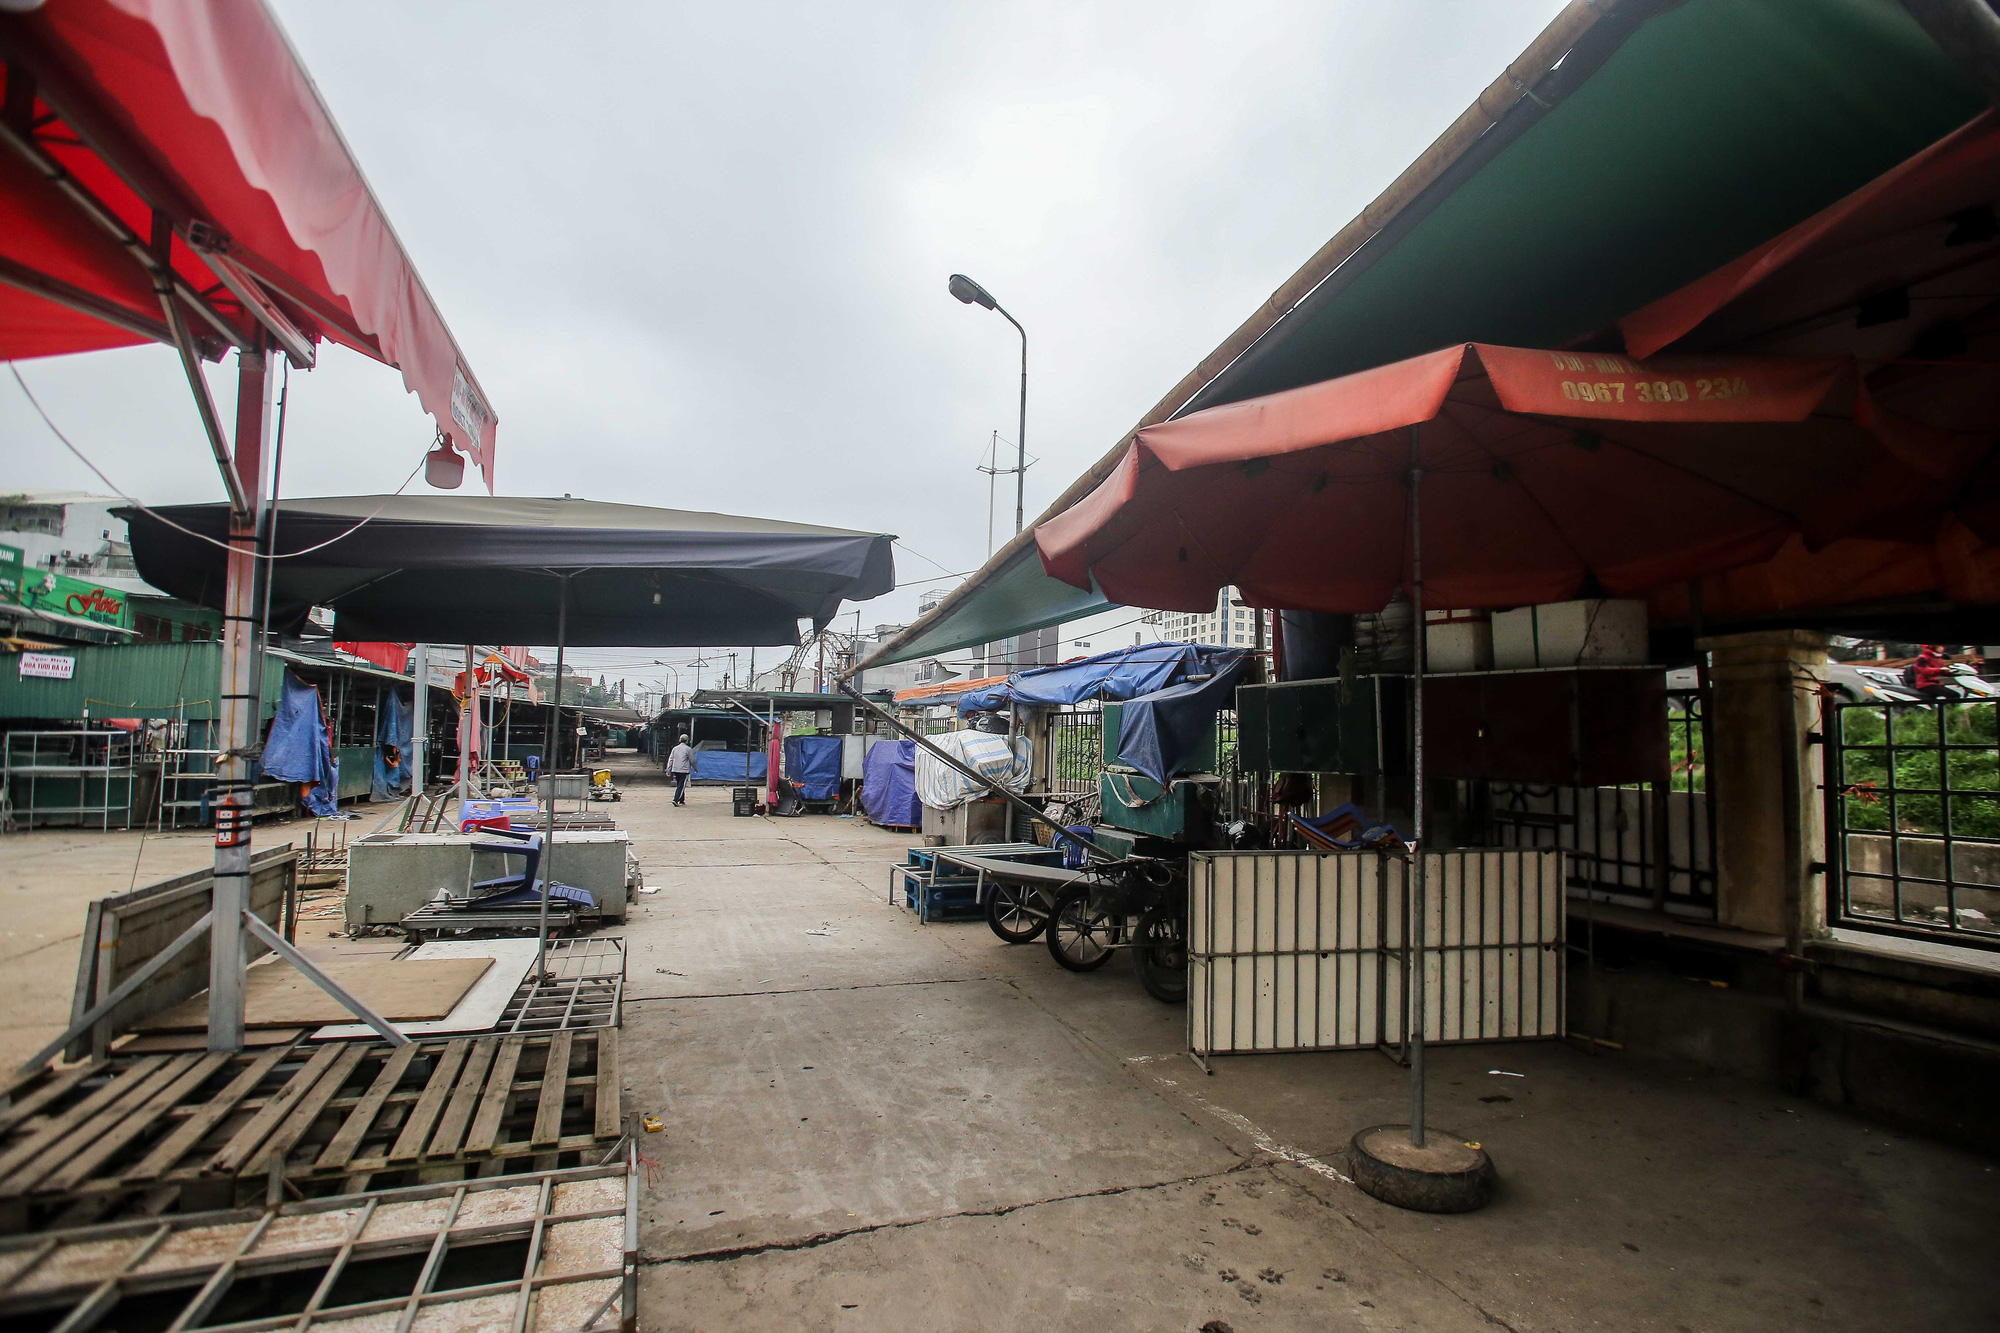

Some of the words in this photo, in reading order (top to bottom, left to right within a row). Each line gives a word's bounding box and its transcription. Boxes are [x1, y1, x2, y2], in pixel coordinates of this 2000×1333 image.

[1561, 380, 1625, 402] 0967
[1634, 380, 1689, 402] 380
[1695, 376, 1749, 399] 234
[66, 588, 123, 616] Flora
